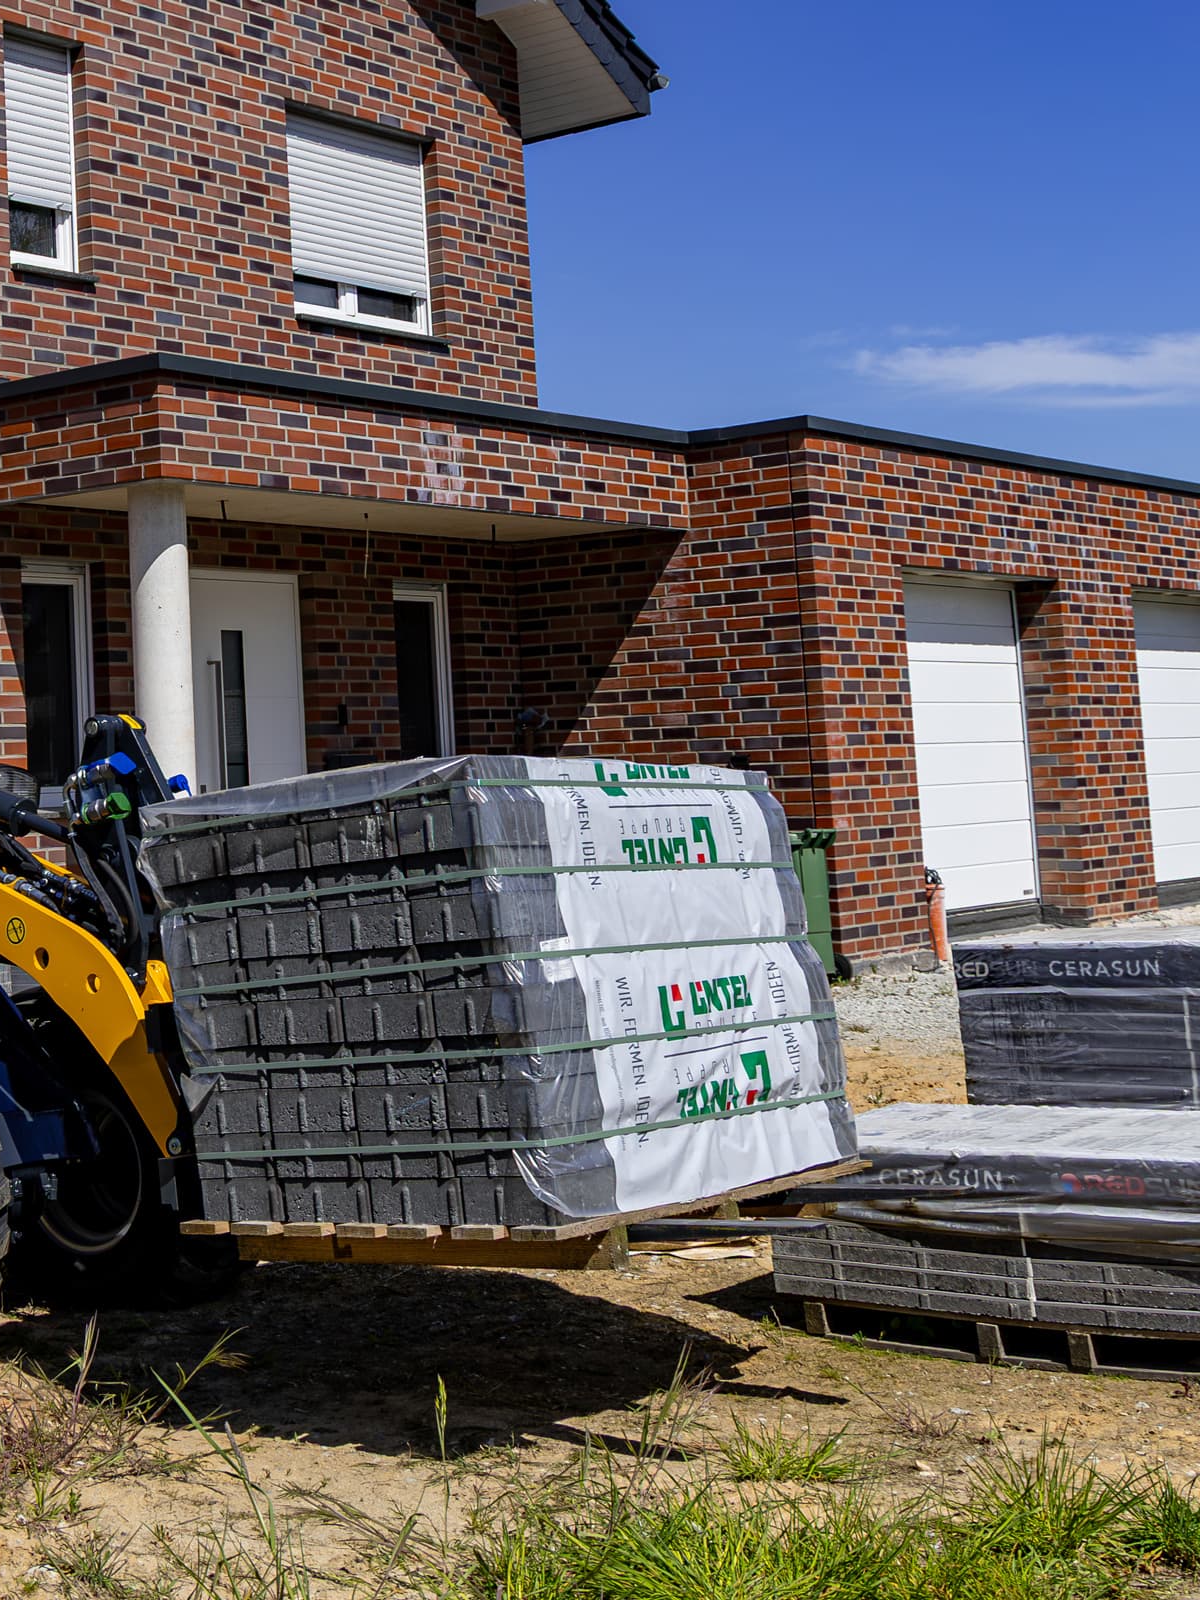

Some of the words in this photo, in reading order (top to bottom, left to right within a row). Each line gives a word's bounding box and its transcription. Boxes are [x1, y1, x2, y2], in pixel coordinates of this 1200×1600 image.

[1049, 959, 1161, 978] CERASUN
[615, 976, 633, 1013] WIR.
[634, 1095, 651, 1149] IDEN.
[878, 1168, 1002, 1190] CERASUN
